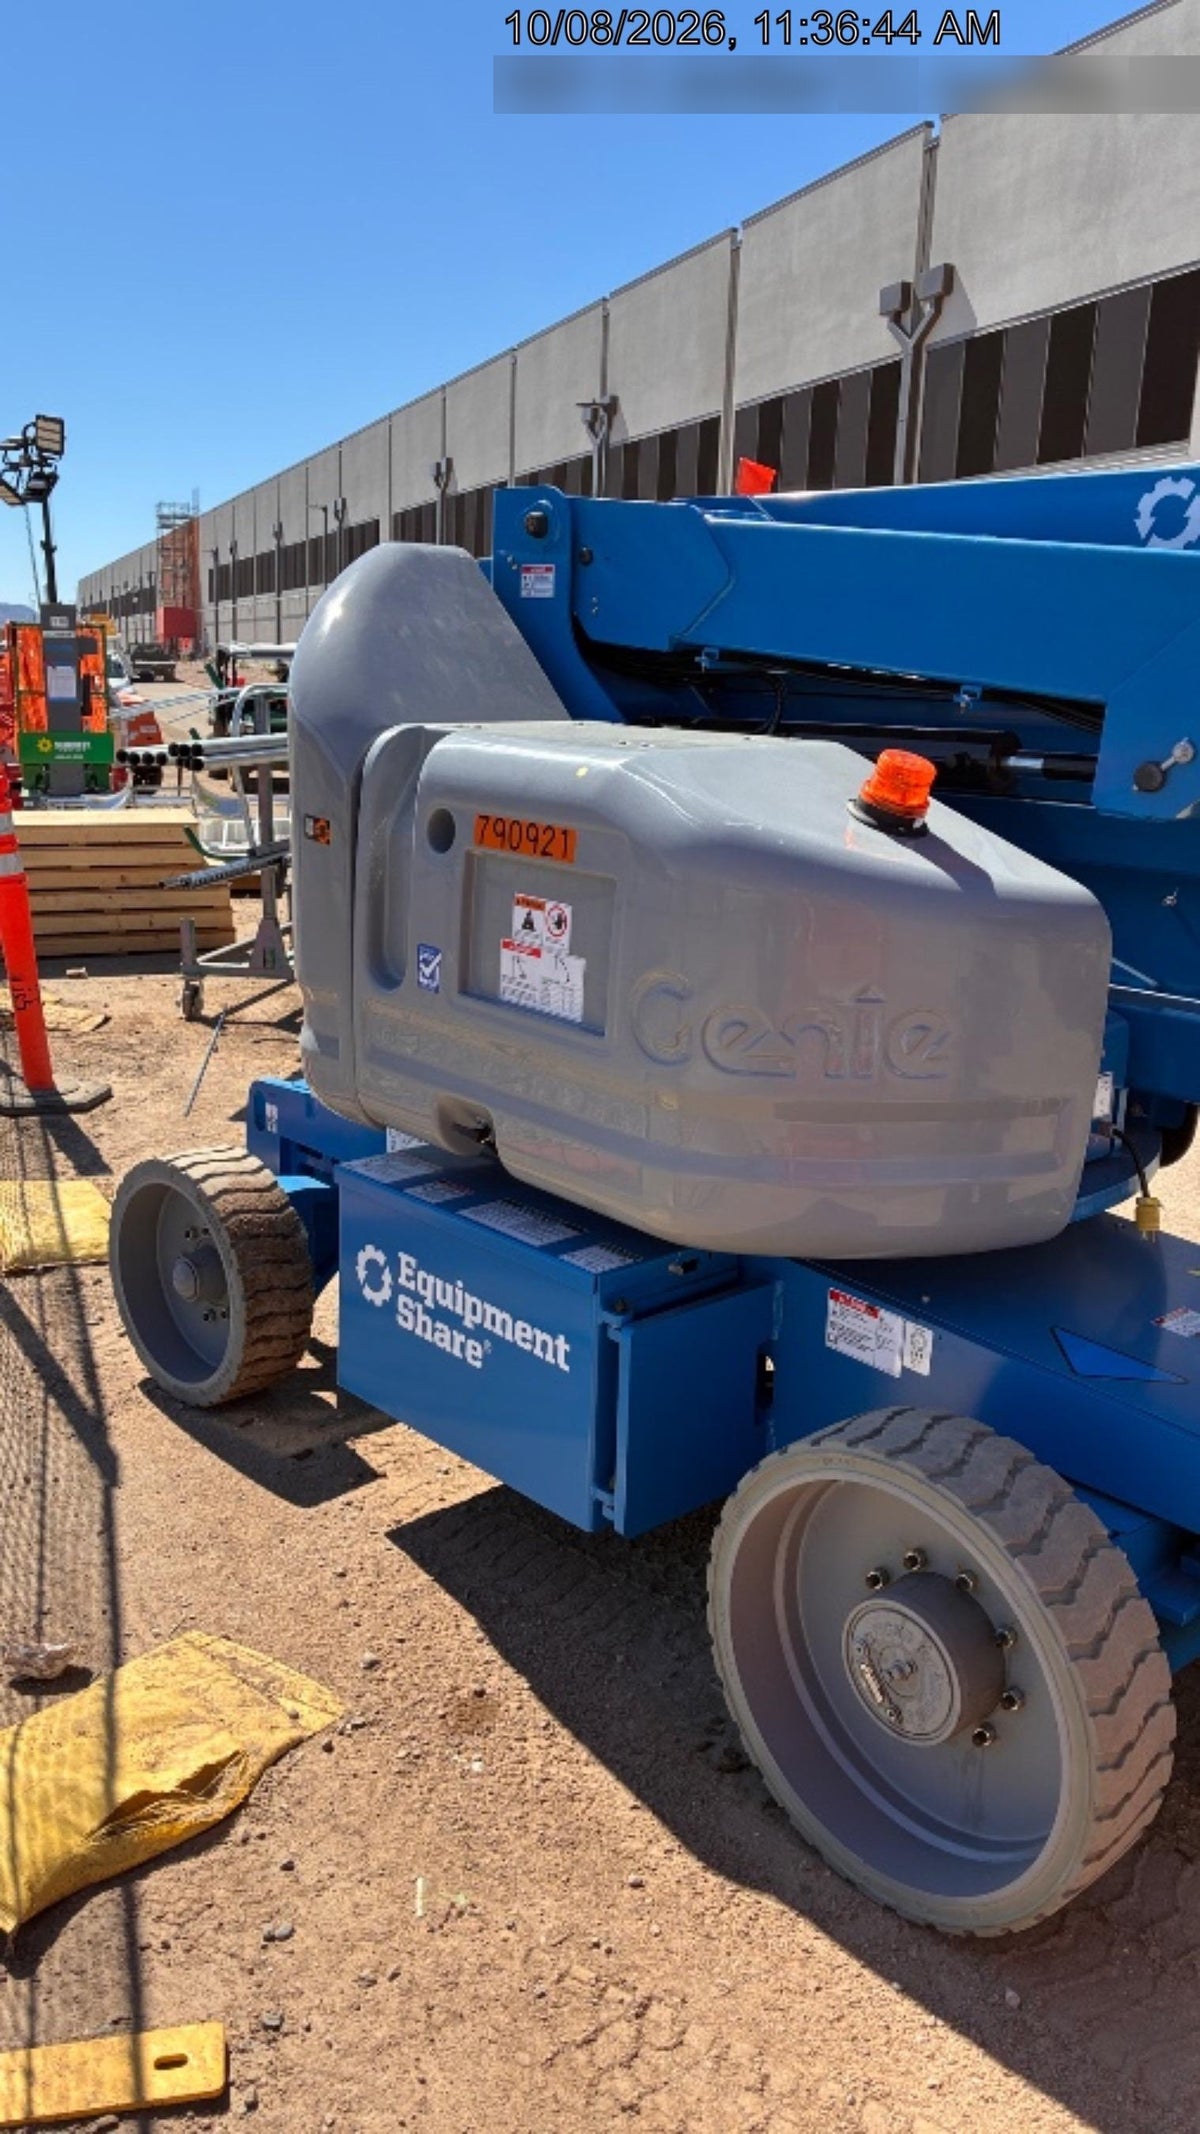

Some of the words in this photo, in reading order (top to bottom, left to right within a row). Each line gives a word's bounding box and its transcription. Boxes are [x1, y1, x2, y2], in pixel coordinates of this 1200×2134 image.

[477, 814, 570, 860] 790921
[632, 967, 952, 1080] Genie
[397, 1250, 571, 1374] Equipment
